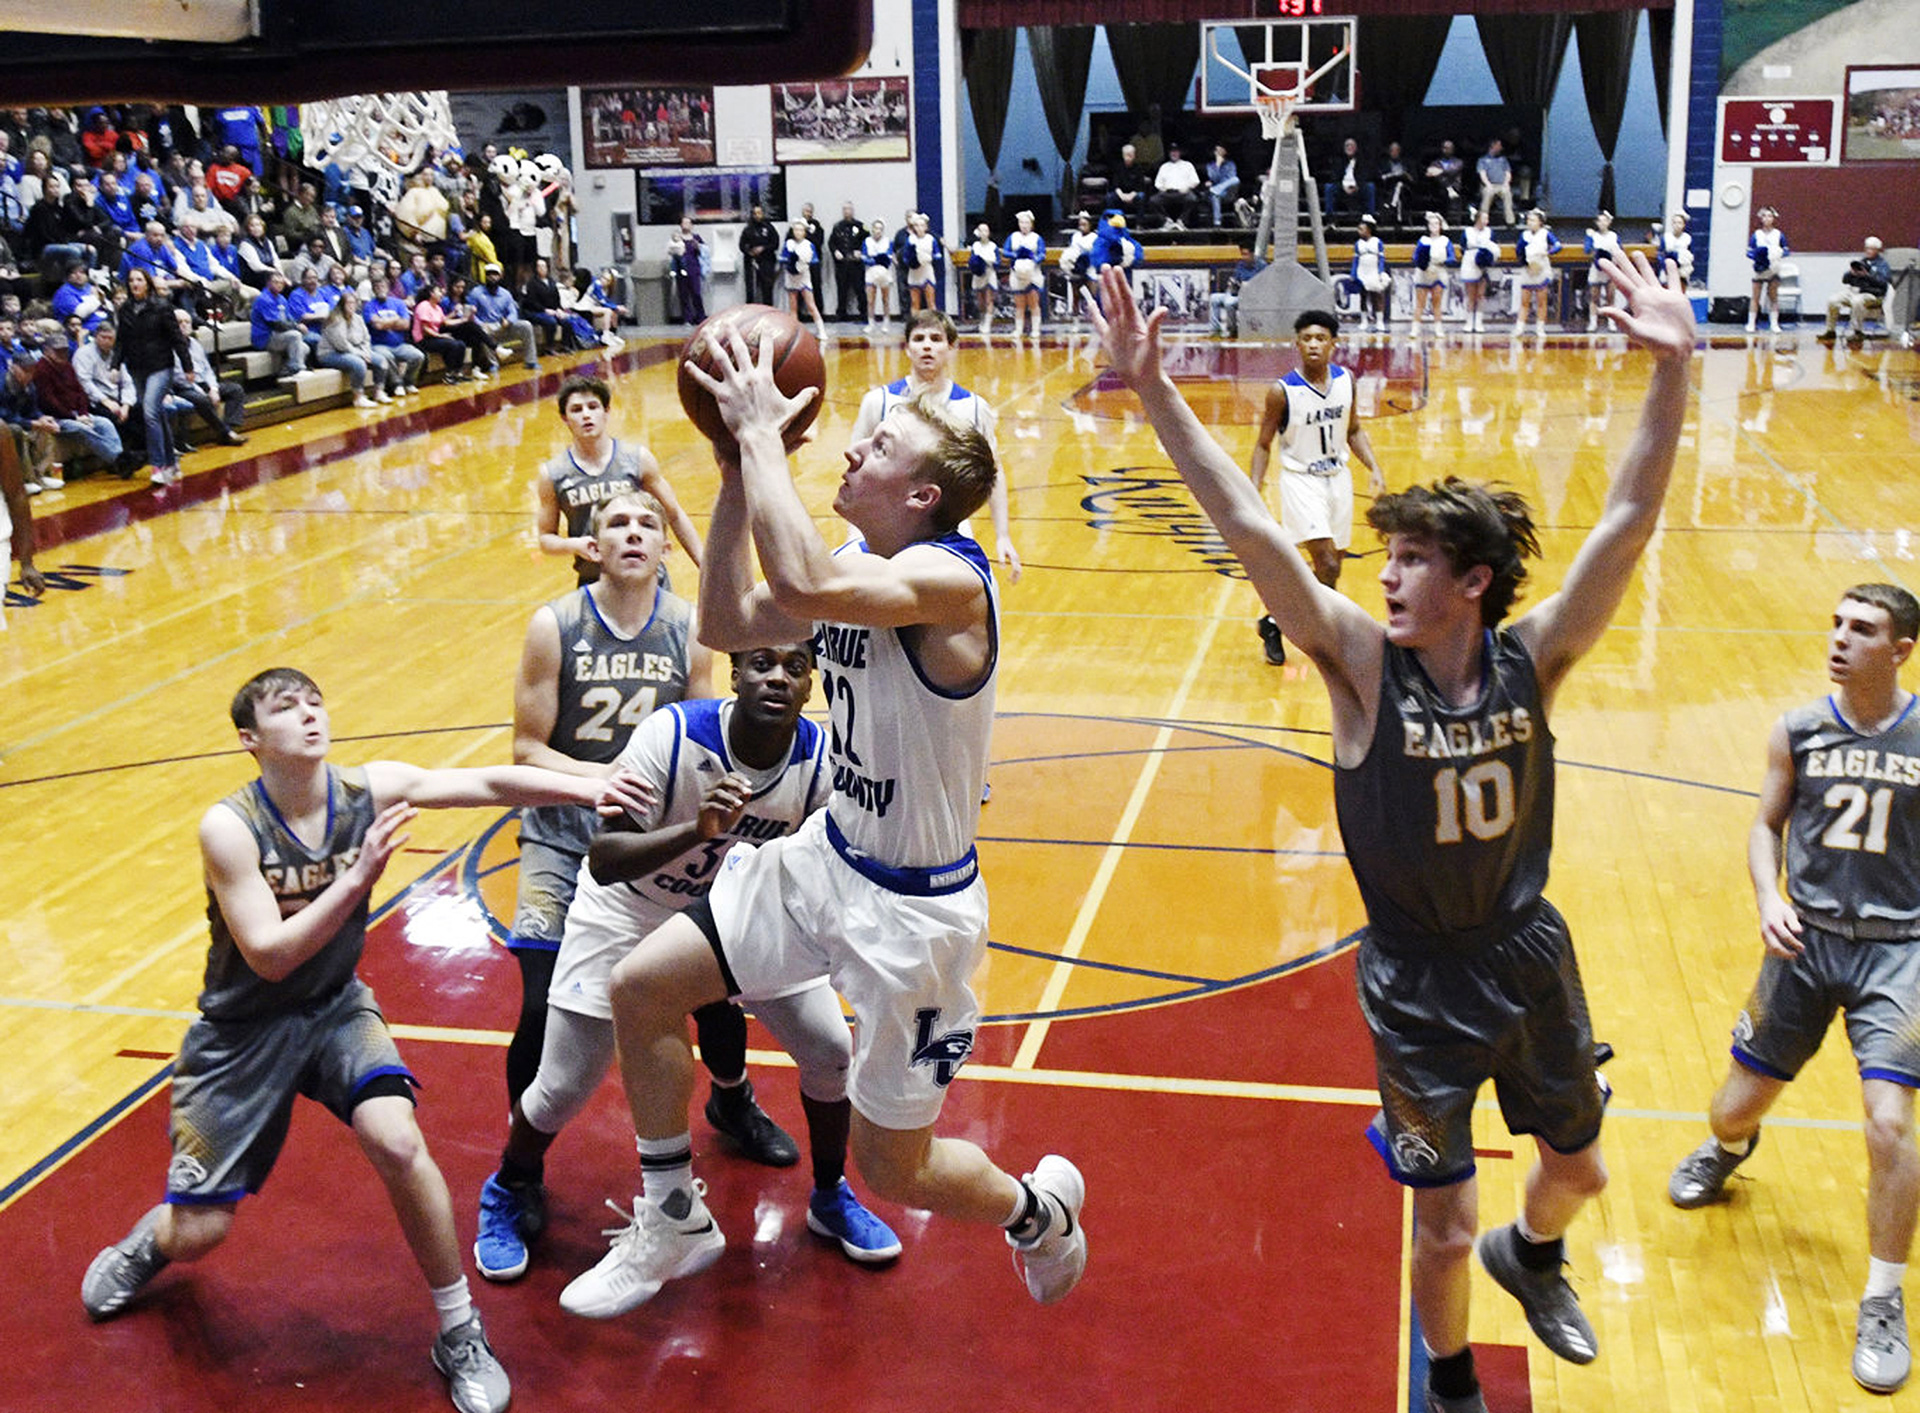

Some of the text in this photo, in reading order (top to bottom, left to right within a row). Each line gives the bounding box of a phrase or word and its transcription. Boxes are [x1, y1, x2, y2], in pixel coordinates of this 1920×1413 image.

[574, 652, 674, 682] EAGLES
[575, 686, 658, 742] 24
[1403, 707, 1533, 759] EAGLES
[1805, 748, 1920, 787] EAGLES
[1433, 759, 1516, 844] 10
[1821, 784, 1895, 855] 21
[685, 838, 728, 879] 3
